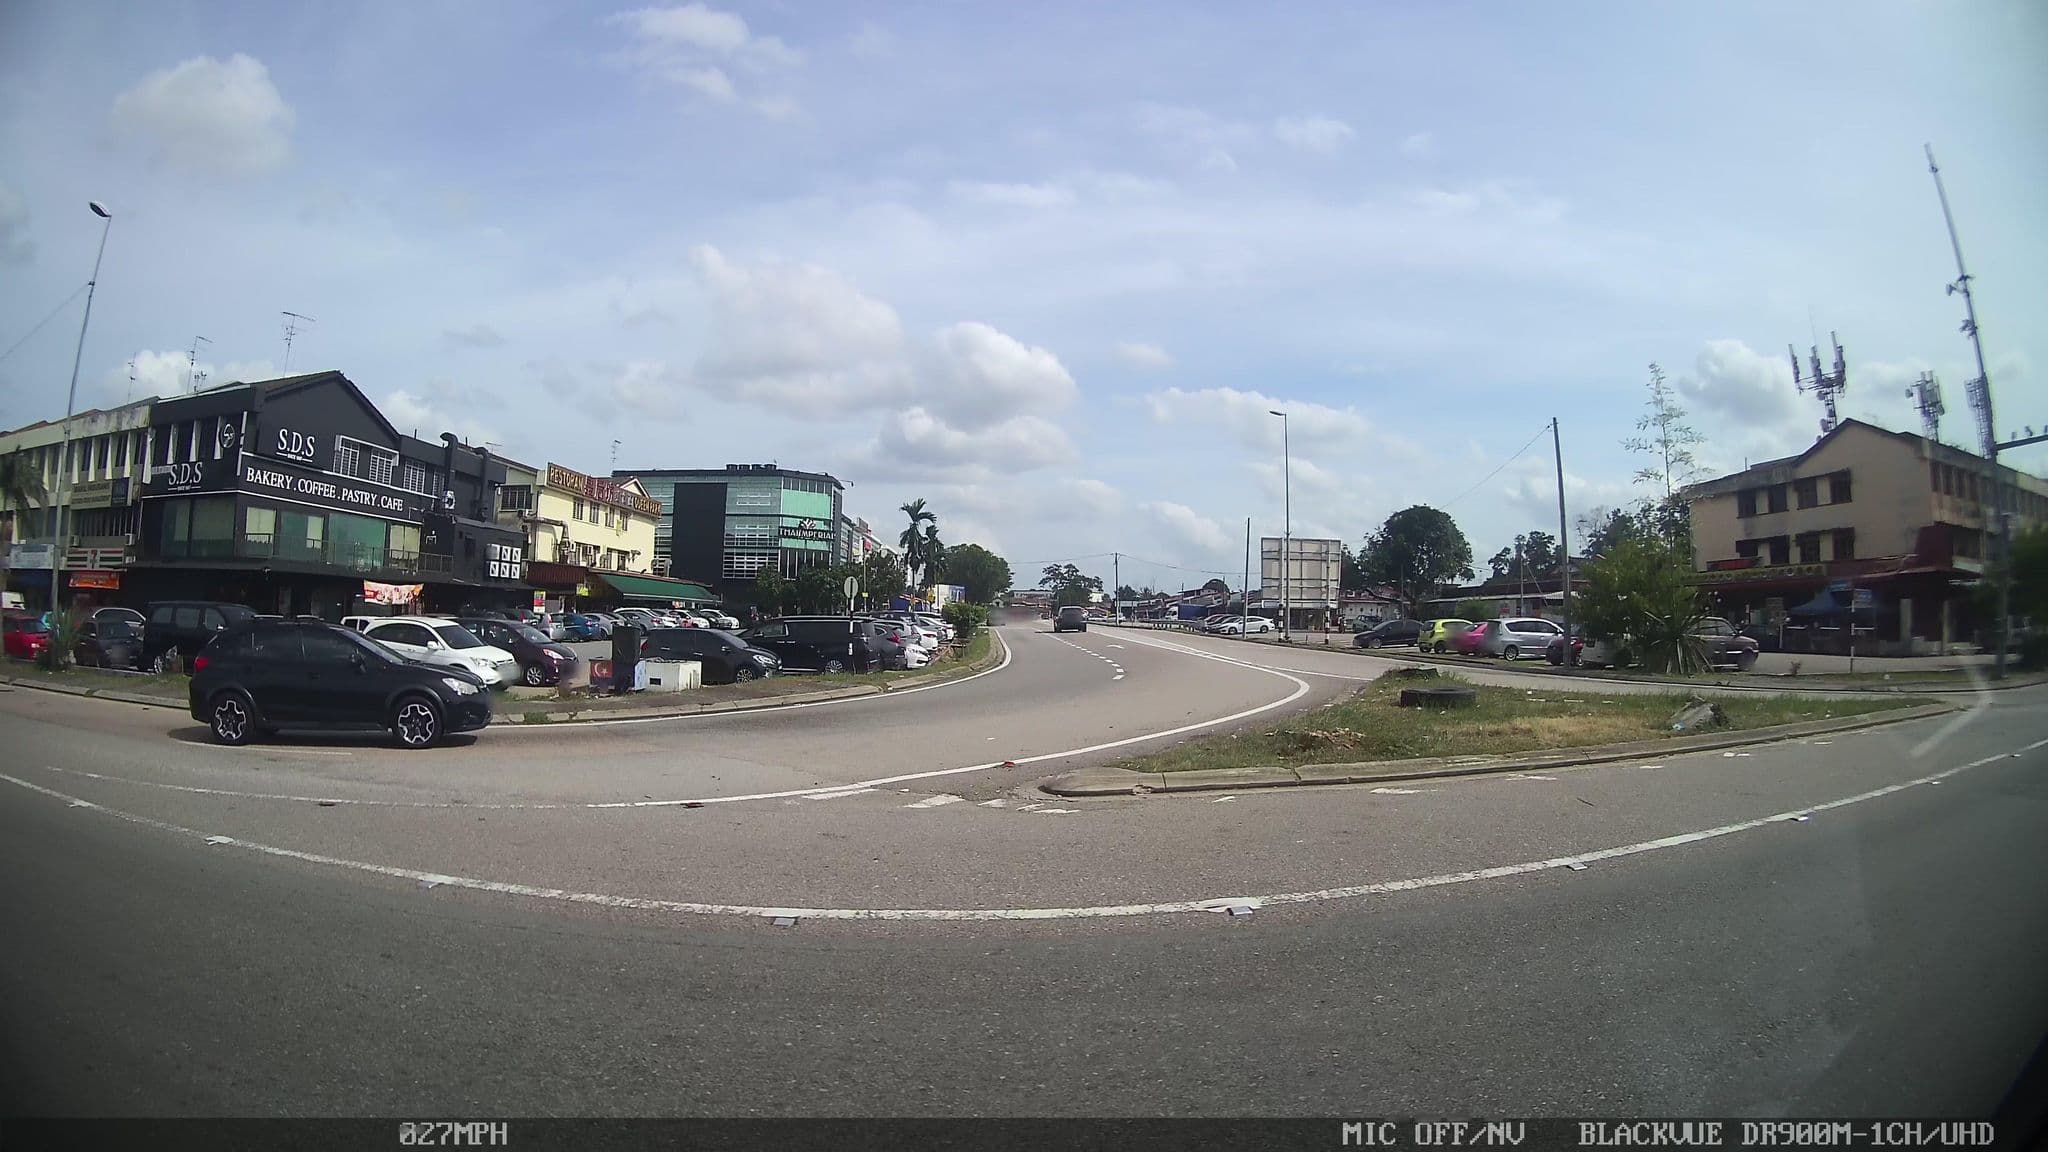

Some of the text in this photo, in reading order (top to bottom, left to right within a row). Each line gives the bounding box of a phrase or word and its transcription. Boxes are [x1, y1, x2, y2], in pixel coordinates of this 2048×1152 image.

[278, 428, 315, 457] S.D.S
[168, 462, 203, 486] S.D.S
[550, 467, 584, 492] RESTORAN
[246, 466, 404, 512] BAKERY COFFEE PASTRY CAFE
